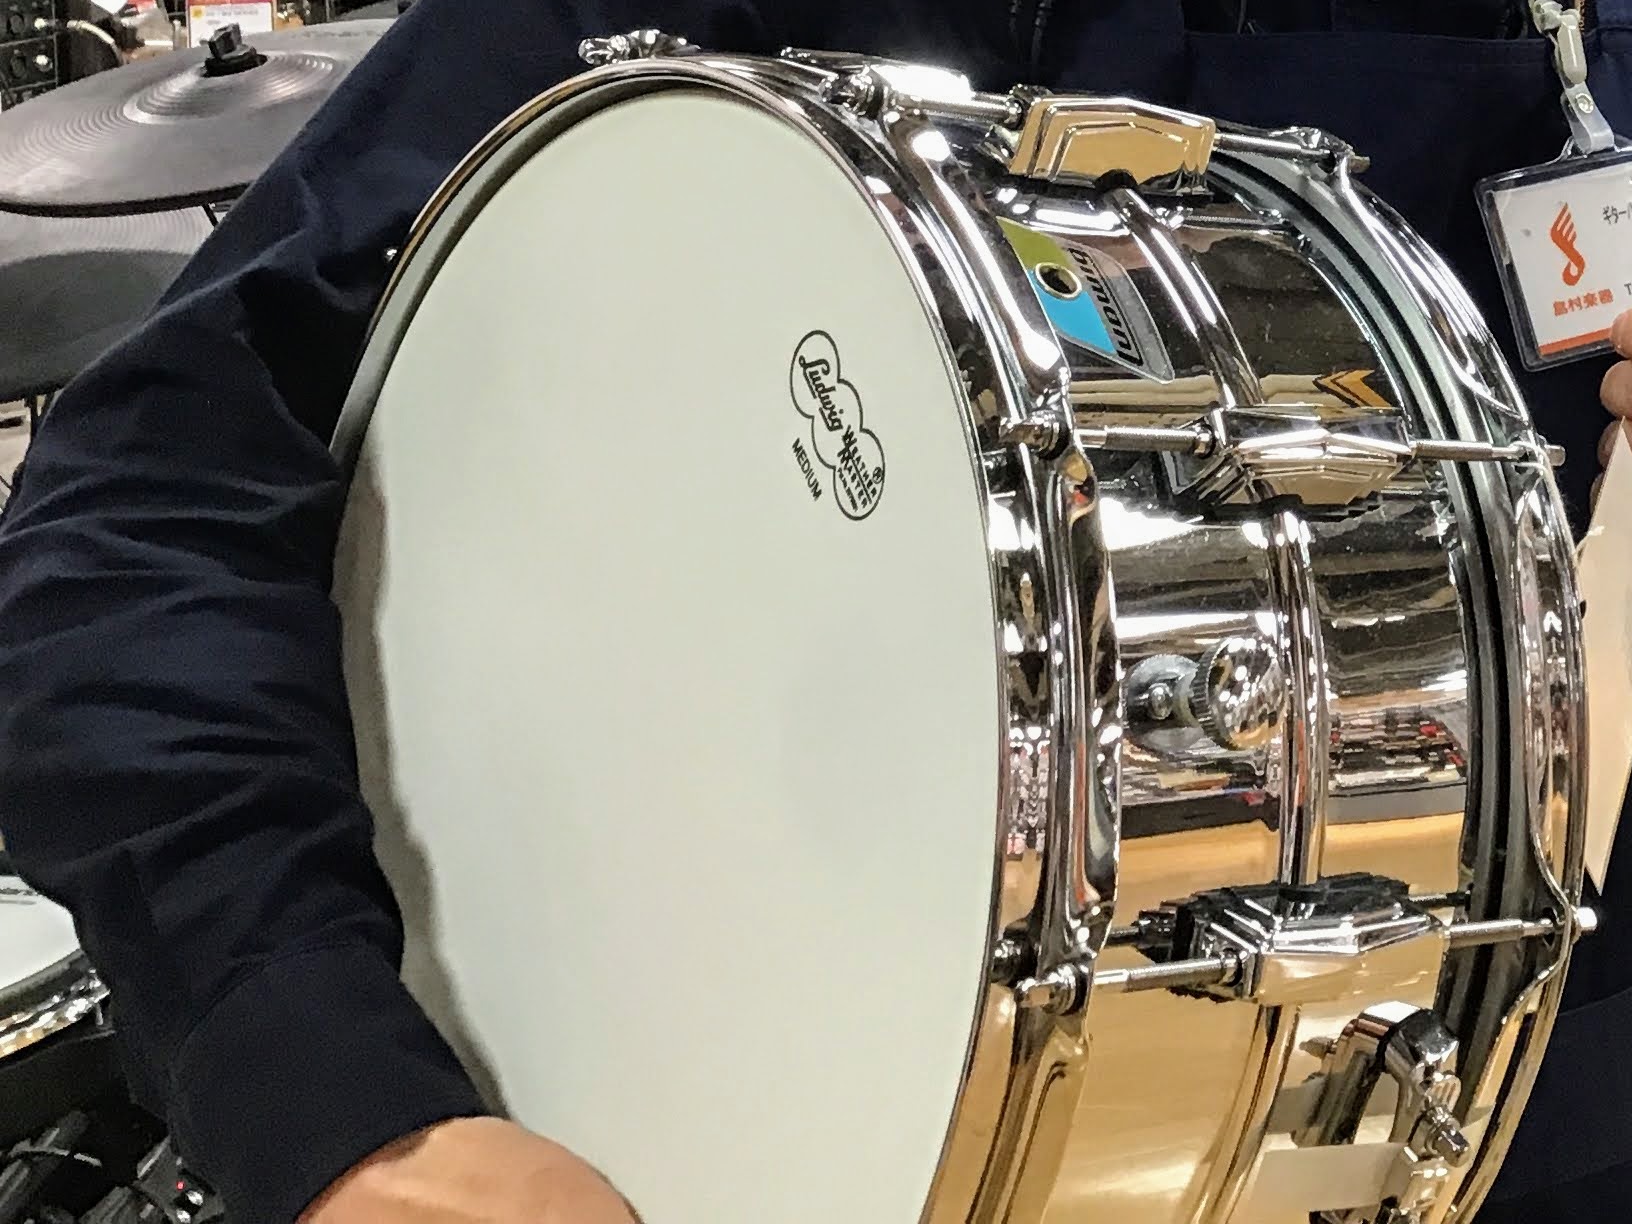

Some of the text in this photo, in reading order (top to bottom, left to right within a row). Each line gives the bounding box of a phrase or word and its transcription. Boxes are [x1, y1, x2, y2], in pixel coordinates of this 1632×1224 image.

[1552, 289, 1614, 317] 島村楽器
[799, 355, 844, 432] Ludwig
[792, 437, 822, 501] MEDIUM
[837, 446, 868, 509] MASTER
[842, 423, 877, 497] WEATHER
